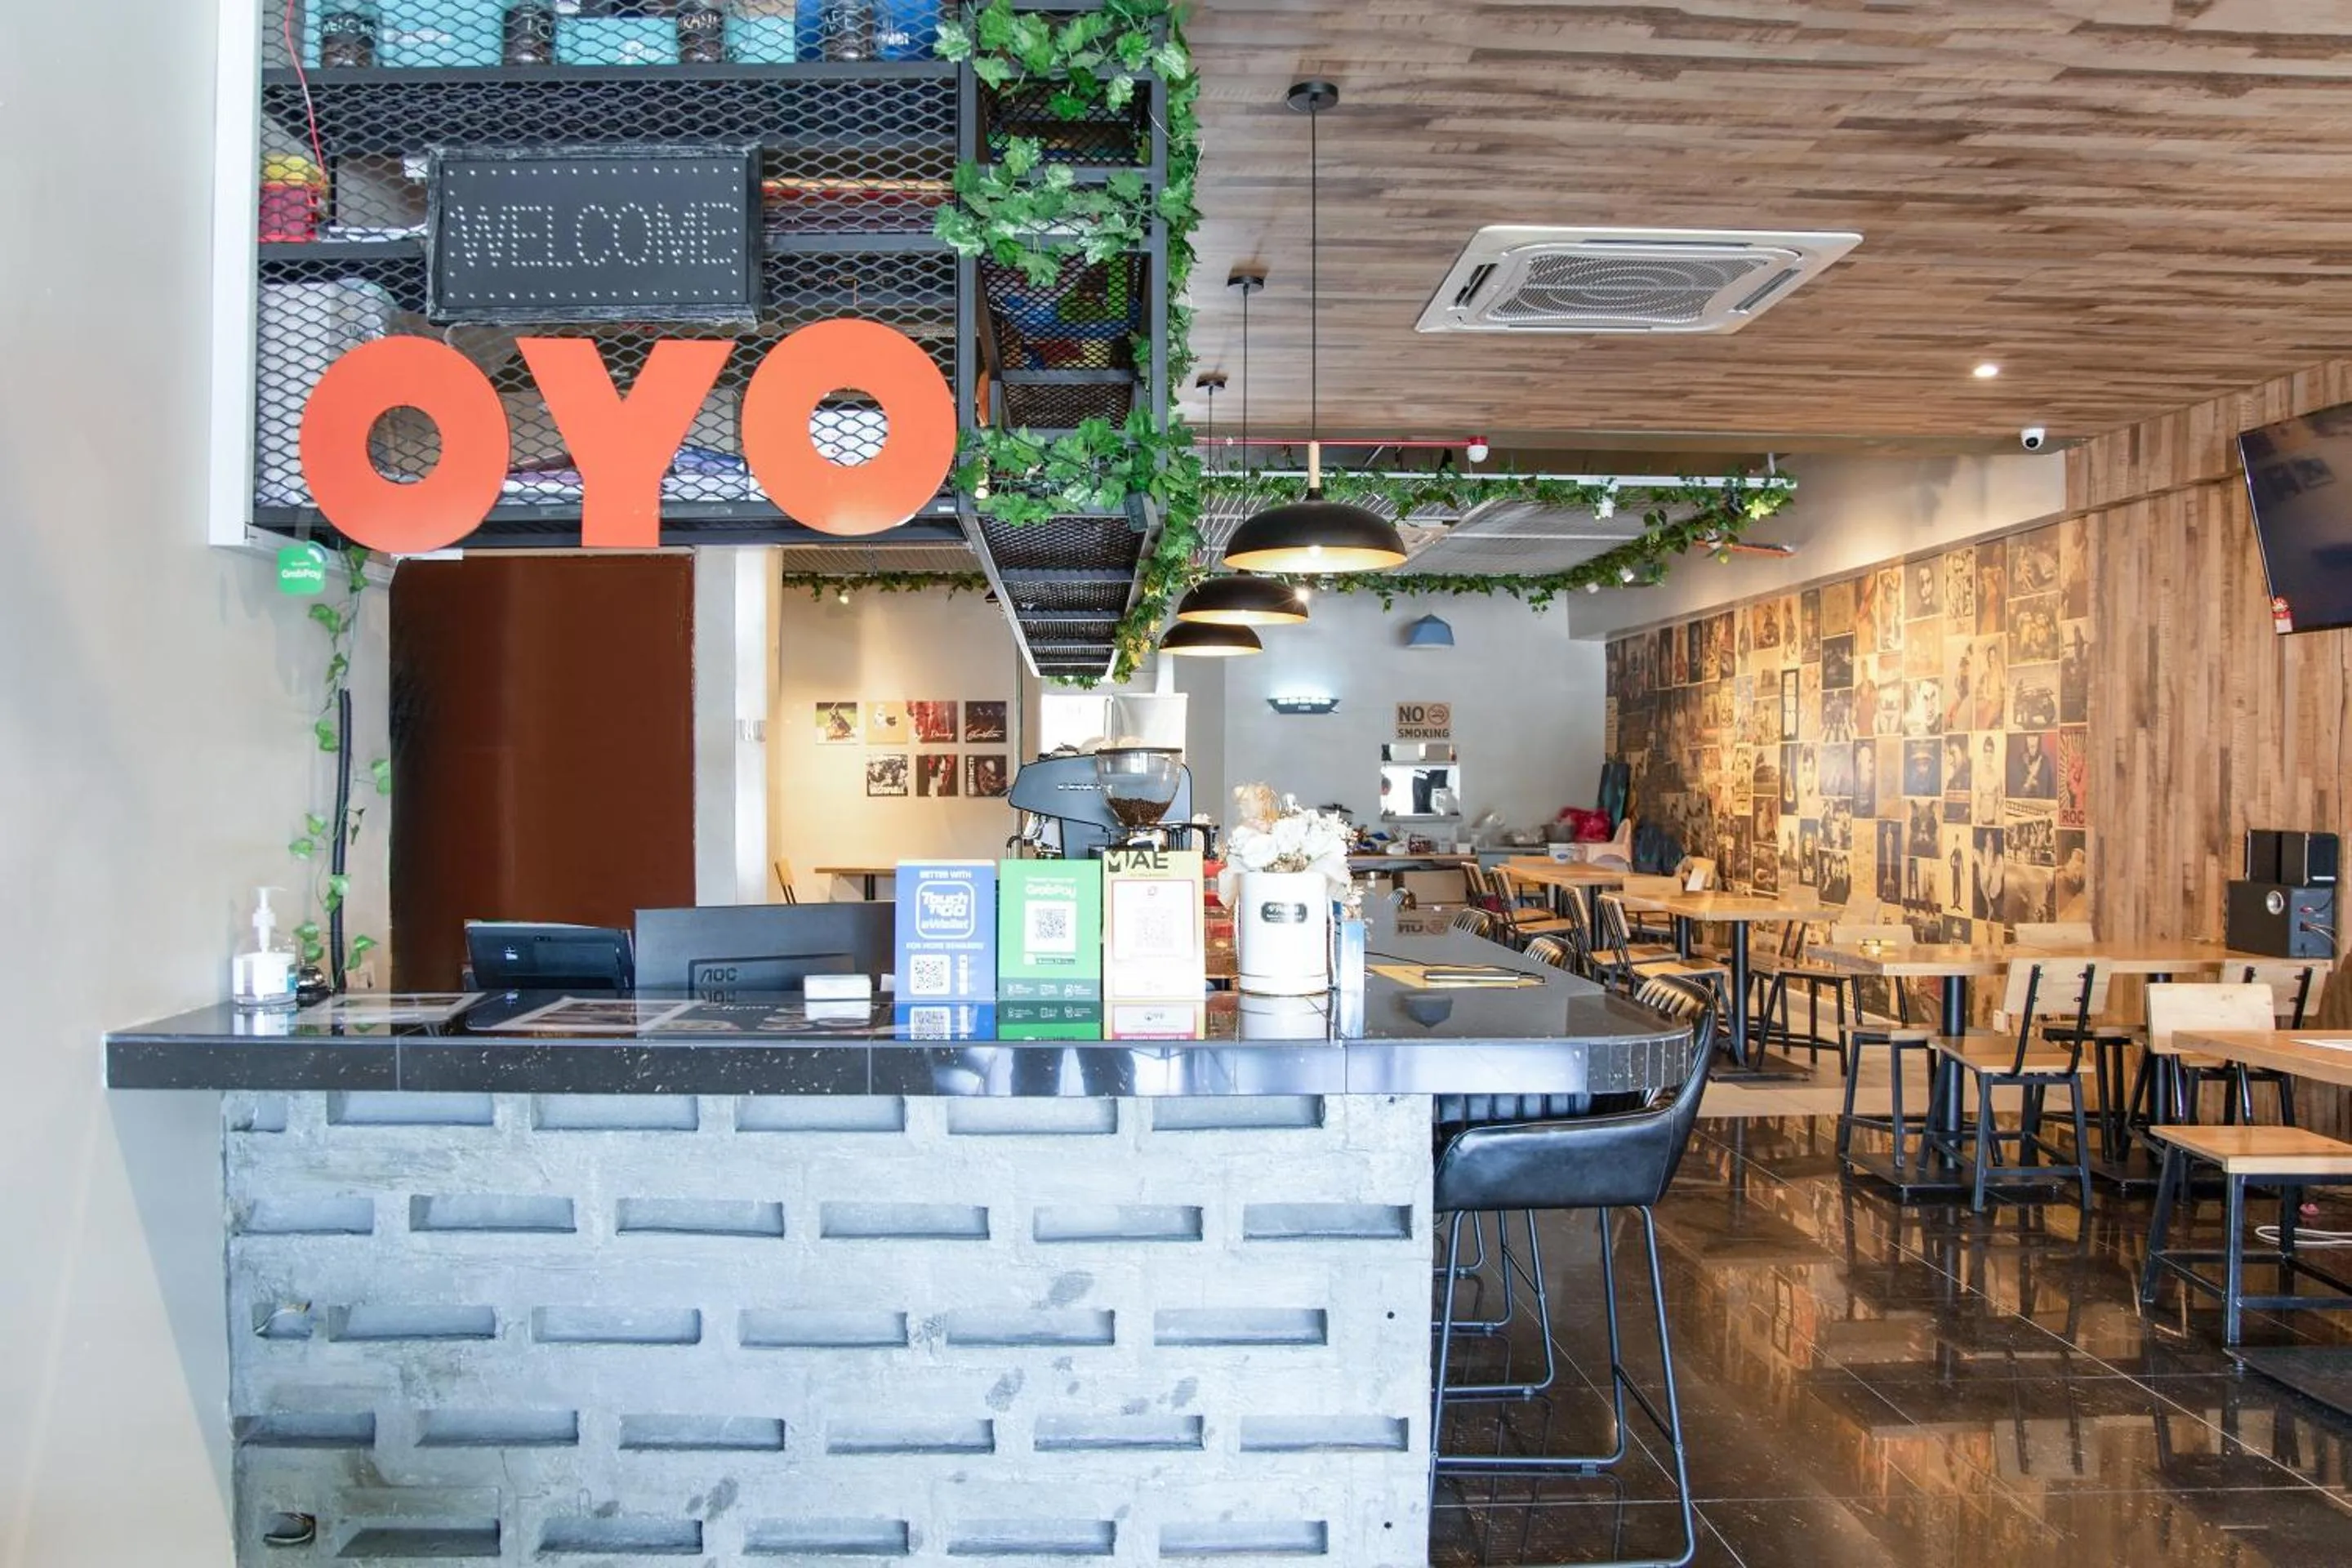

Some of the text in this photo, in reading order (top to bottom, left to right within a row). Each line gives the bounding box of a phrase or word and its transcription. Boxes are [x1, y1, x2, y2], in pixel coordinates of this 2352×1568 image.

[457, 203, 733, 267] WELCOME
[299, 318, 958, 554] OYO
[1398, 706, 1424, 722] NO
[1398, 728, 1450, 738] SMOKING
[950, 871, 972, 879] WITH
[921, 891, 969, 905] Touch
[700, 967, 737, 982] AOC
